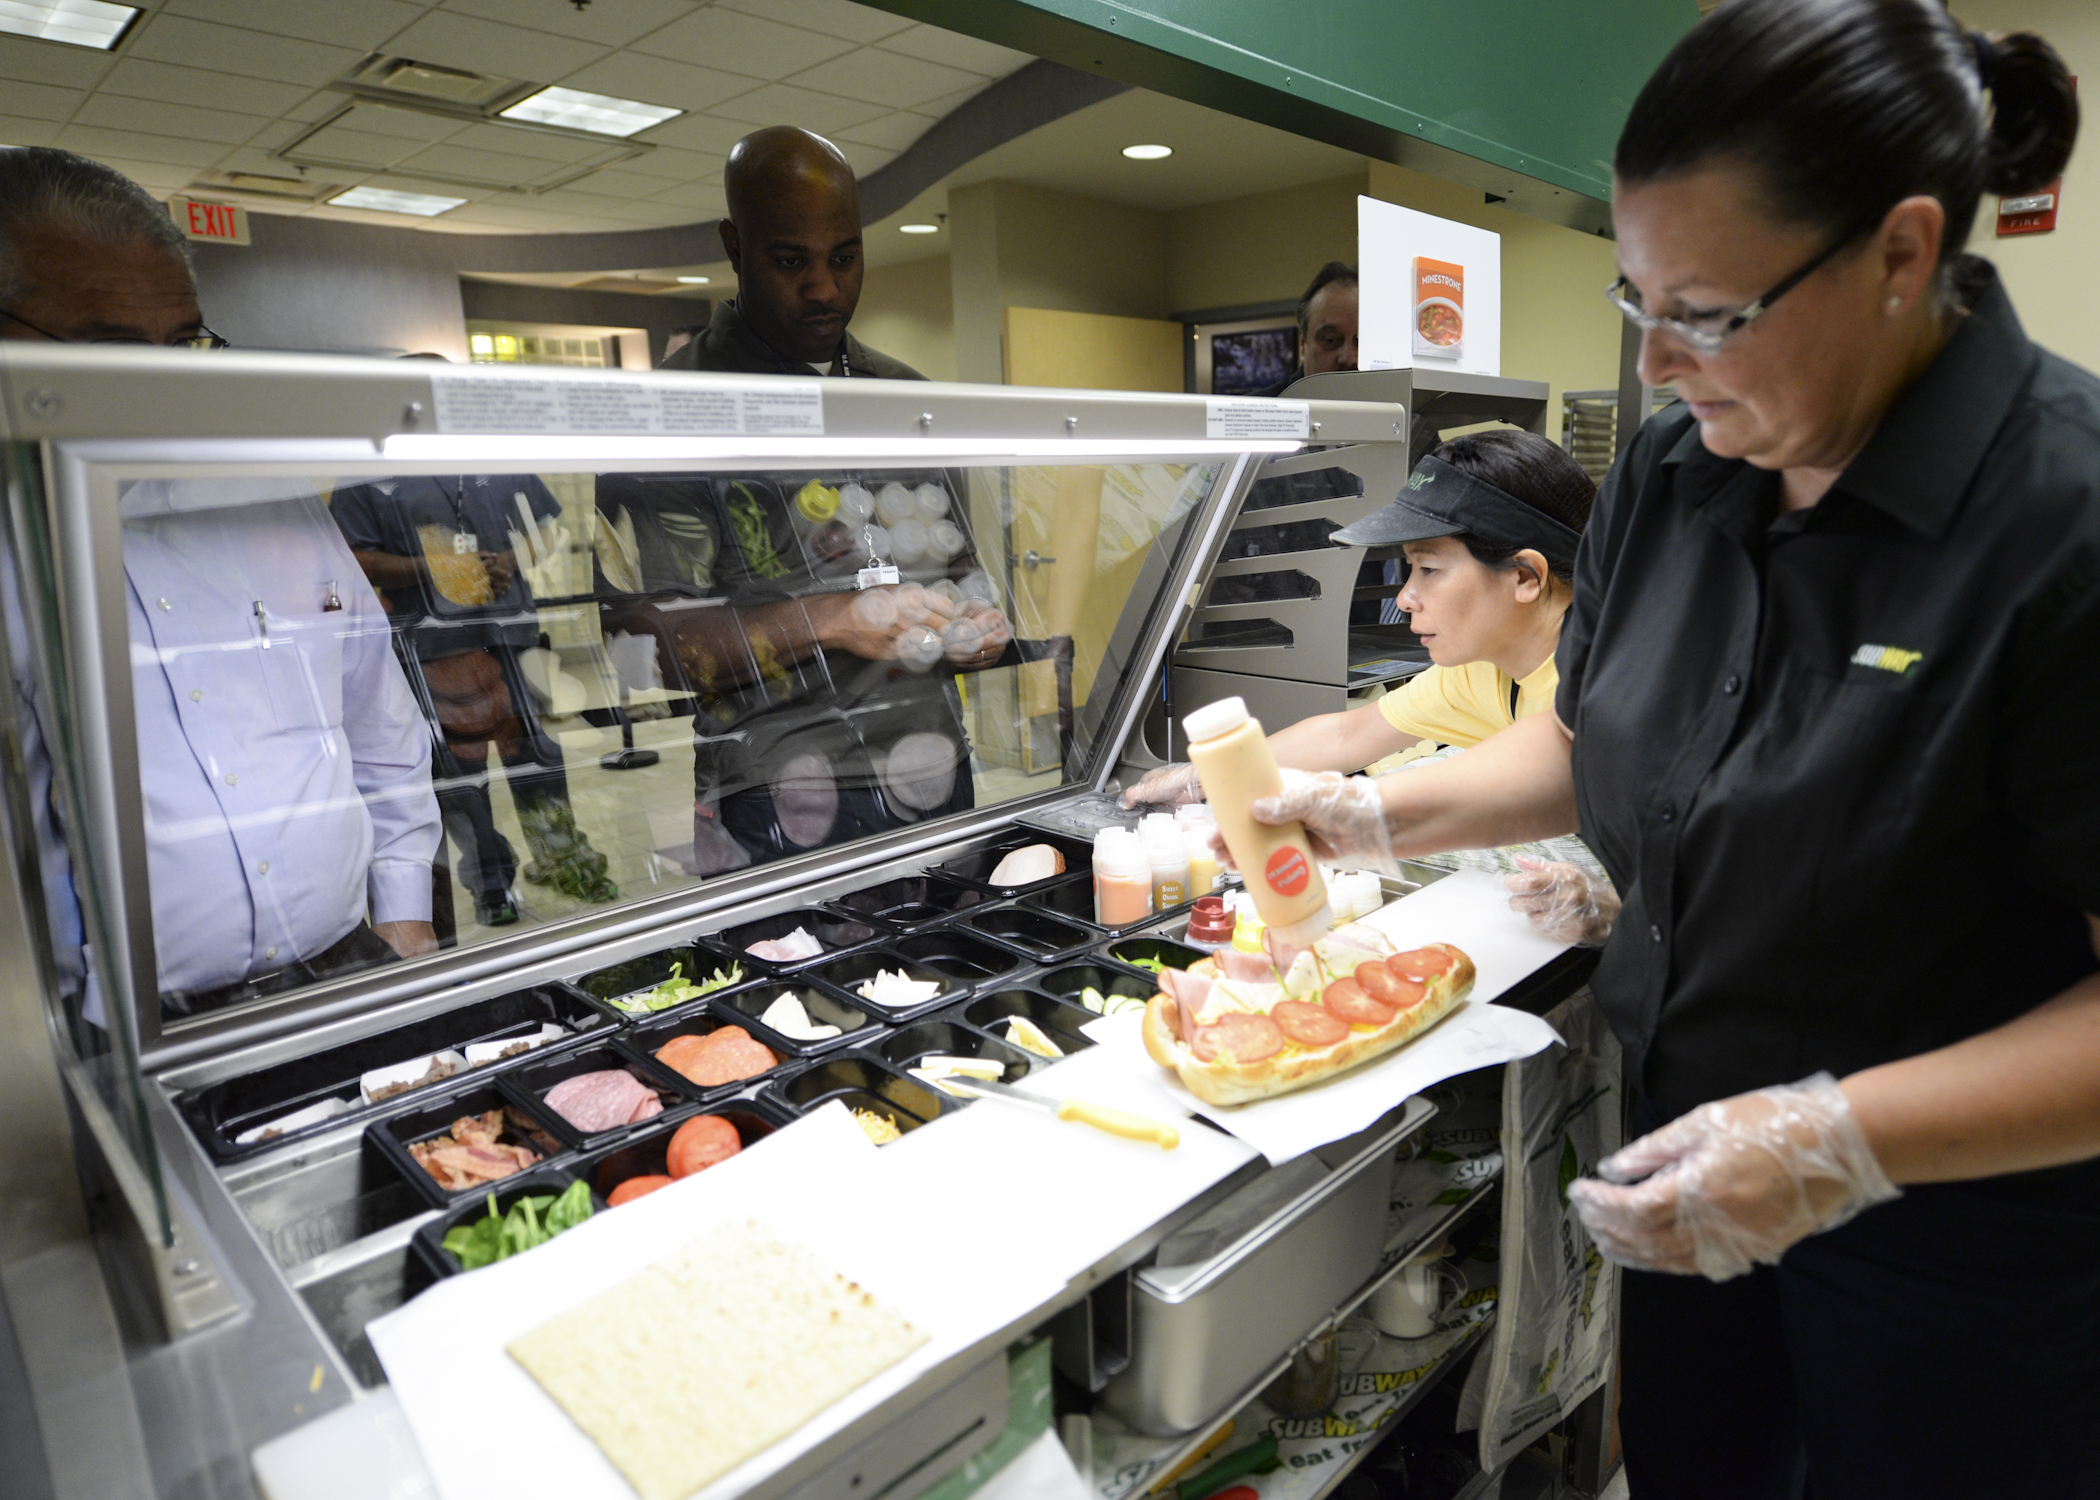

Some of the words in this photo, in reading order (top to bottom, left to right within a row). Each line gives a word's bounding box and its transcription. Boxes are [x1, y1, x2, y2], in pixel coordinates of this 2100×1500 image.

[186, 202, 236, 238] EXIT
[2010, 217, 2041, 228] FIRE
[1421, 274, 1462, 292] MINESTRONE
[1289, 1448, 1335, 1468] eat
